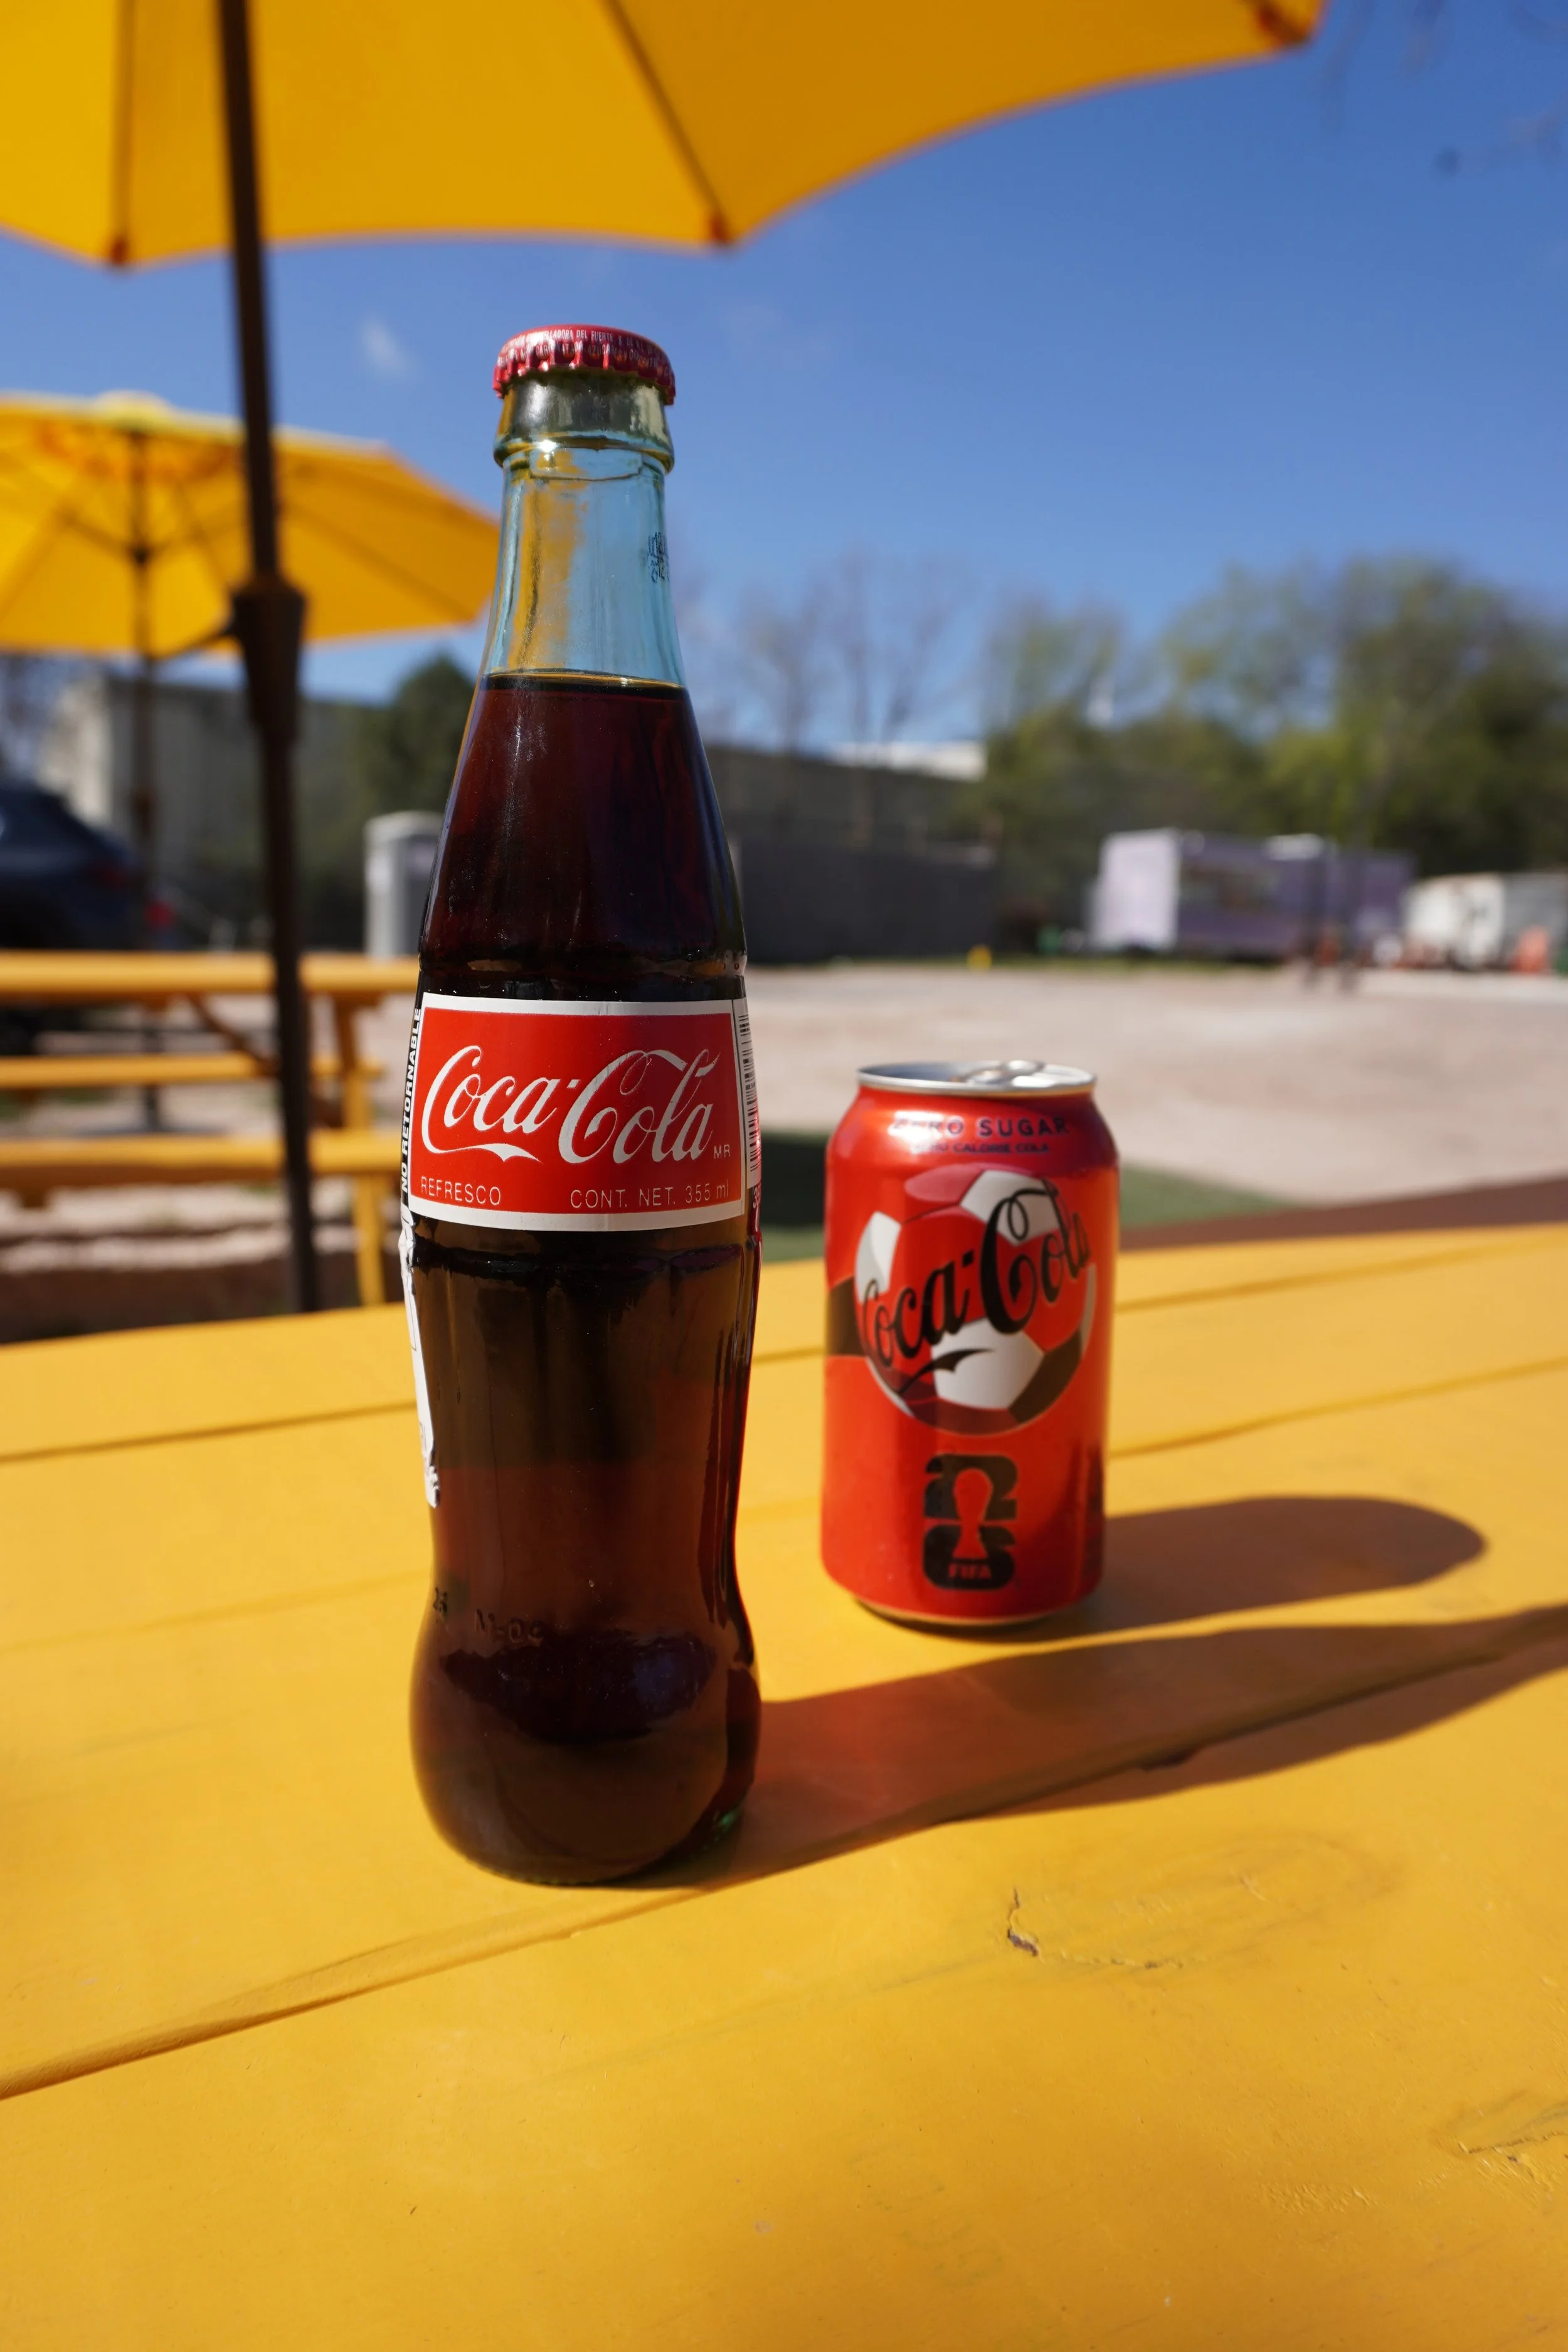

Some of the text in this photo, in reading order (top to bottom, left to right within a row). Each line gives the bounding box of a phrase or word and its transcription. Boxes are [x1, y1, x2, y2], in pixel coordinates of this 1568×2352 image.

[576, 329, 588, 339] DEL
[401, 1008, 421, 1192] NO RETORNABLE
[421, 1045, 721, 1164] Coca-Cola
[893, 1118, 1070, 1138] ZRO SUGAR
[714, 1146, 731, 1160] MR
[420, 1175, 501, 1206] REFRESCO
[570, 1184, 729, 1209] CONT. NET. 355 ml
[862, 1179, 1091, 1394] Coca-Cola
[948, 1563, 992, 1580] FIFA
